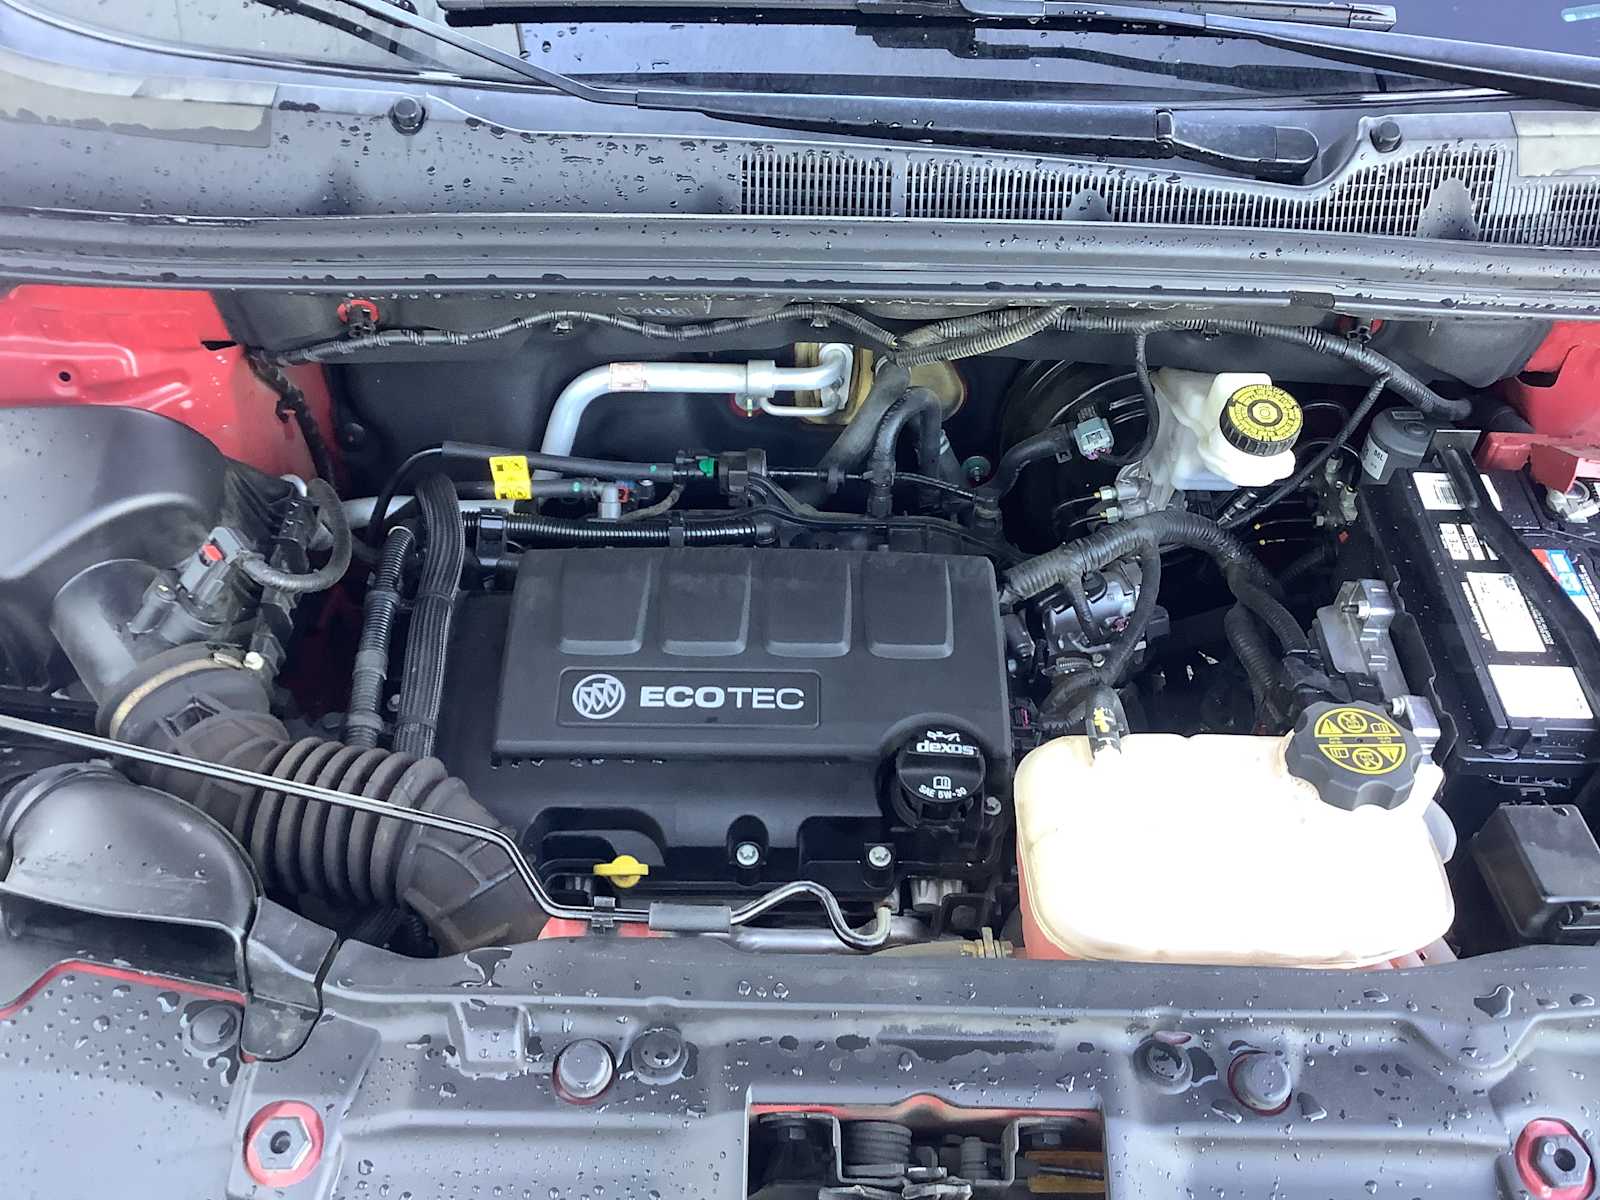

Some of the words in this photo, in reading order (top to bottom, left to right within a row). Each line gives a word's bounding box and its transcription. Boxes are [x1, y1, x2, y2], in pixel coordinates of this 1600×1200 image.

[640, 686, 805, 709] ECOTEC
[916, 740, 975, 755] dexos
[919, 784, 936, 797] SAE
[937, 787, 967, 799] 5W-30
